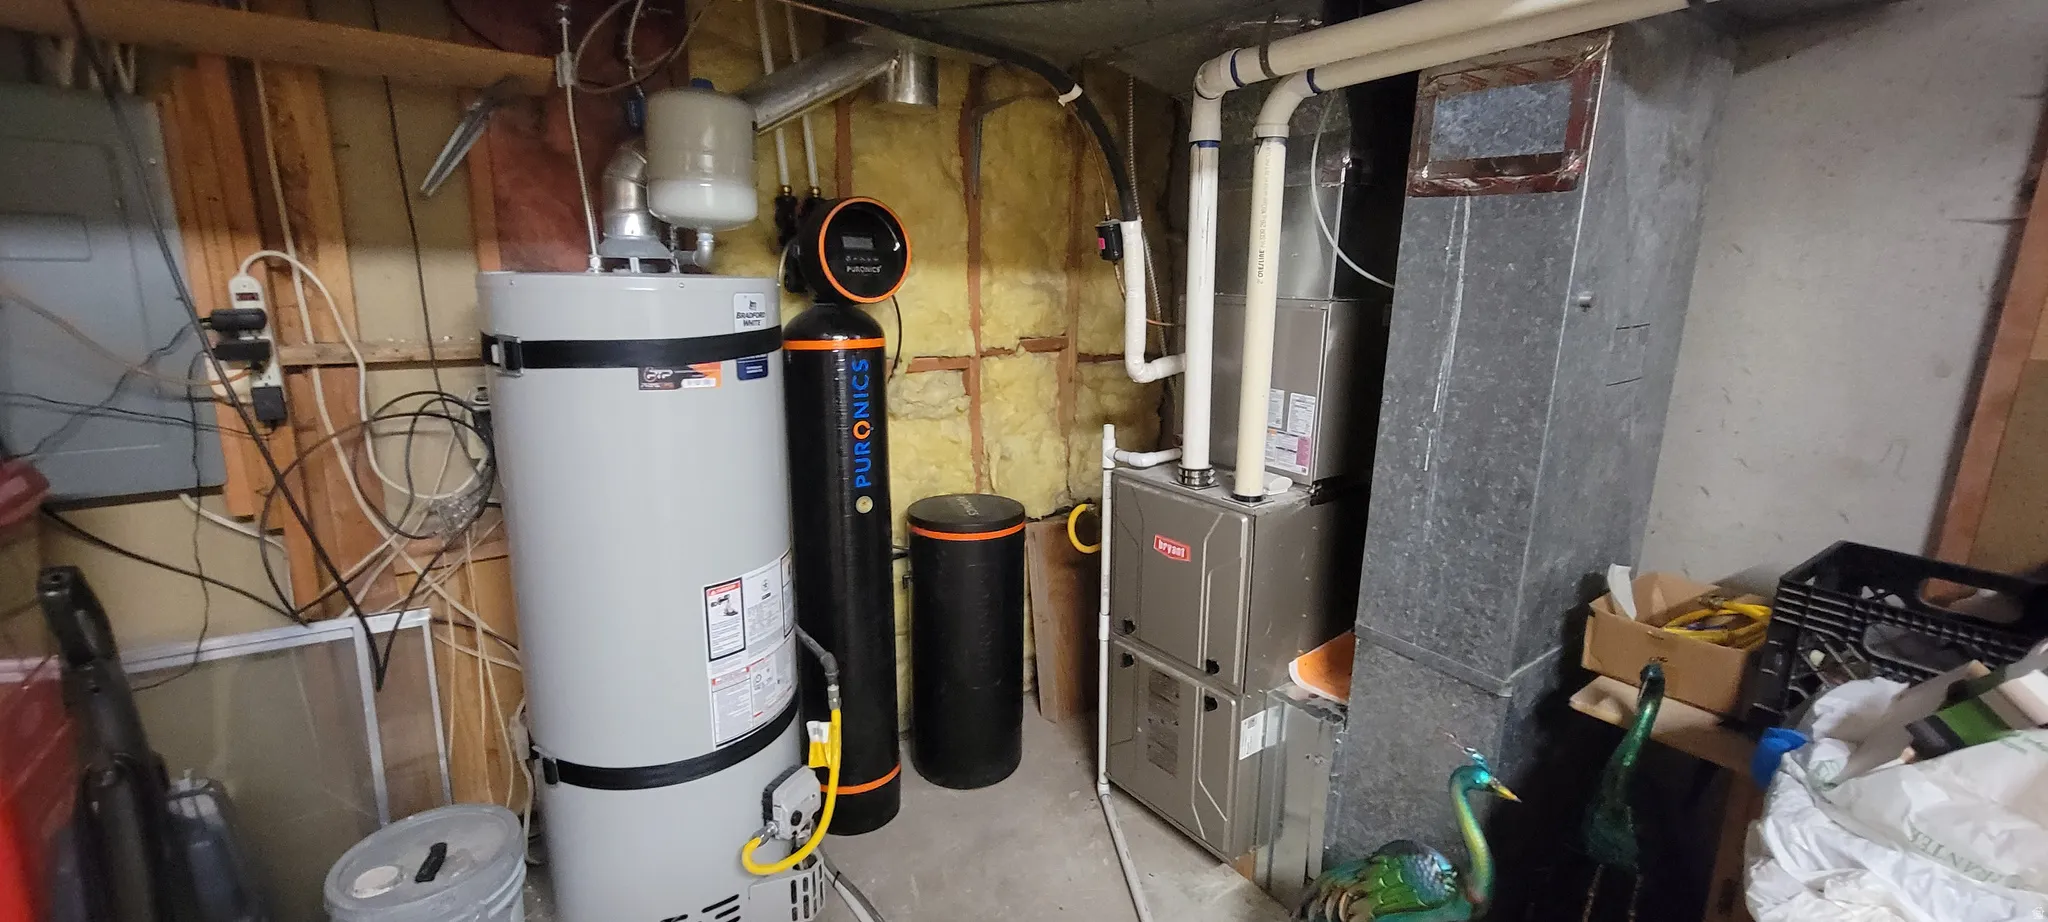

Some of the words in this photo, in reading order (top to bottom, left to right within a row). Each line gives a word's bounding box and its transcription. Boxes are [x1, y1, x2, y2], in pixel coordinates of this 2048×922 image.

[846, 265, 881, 273] PURONICS
[743, 319, 761, 327] WHITE
[852, 358, 873, 489] PURONICS
[1158, 539, 1186, 558] bryant
